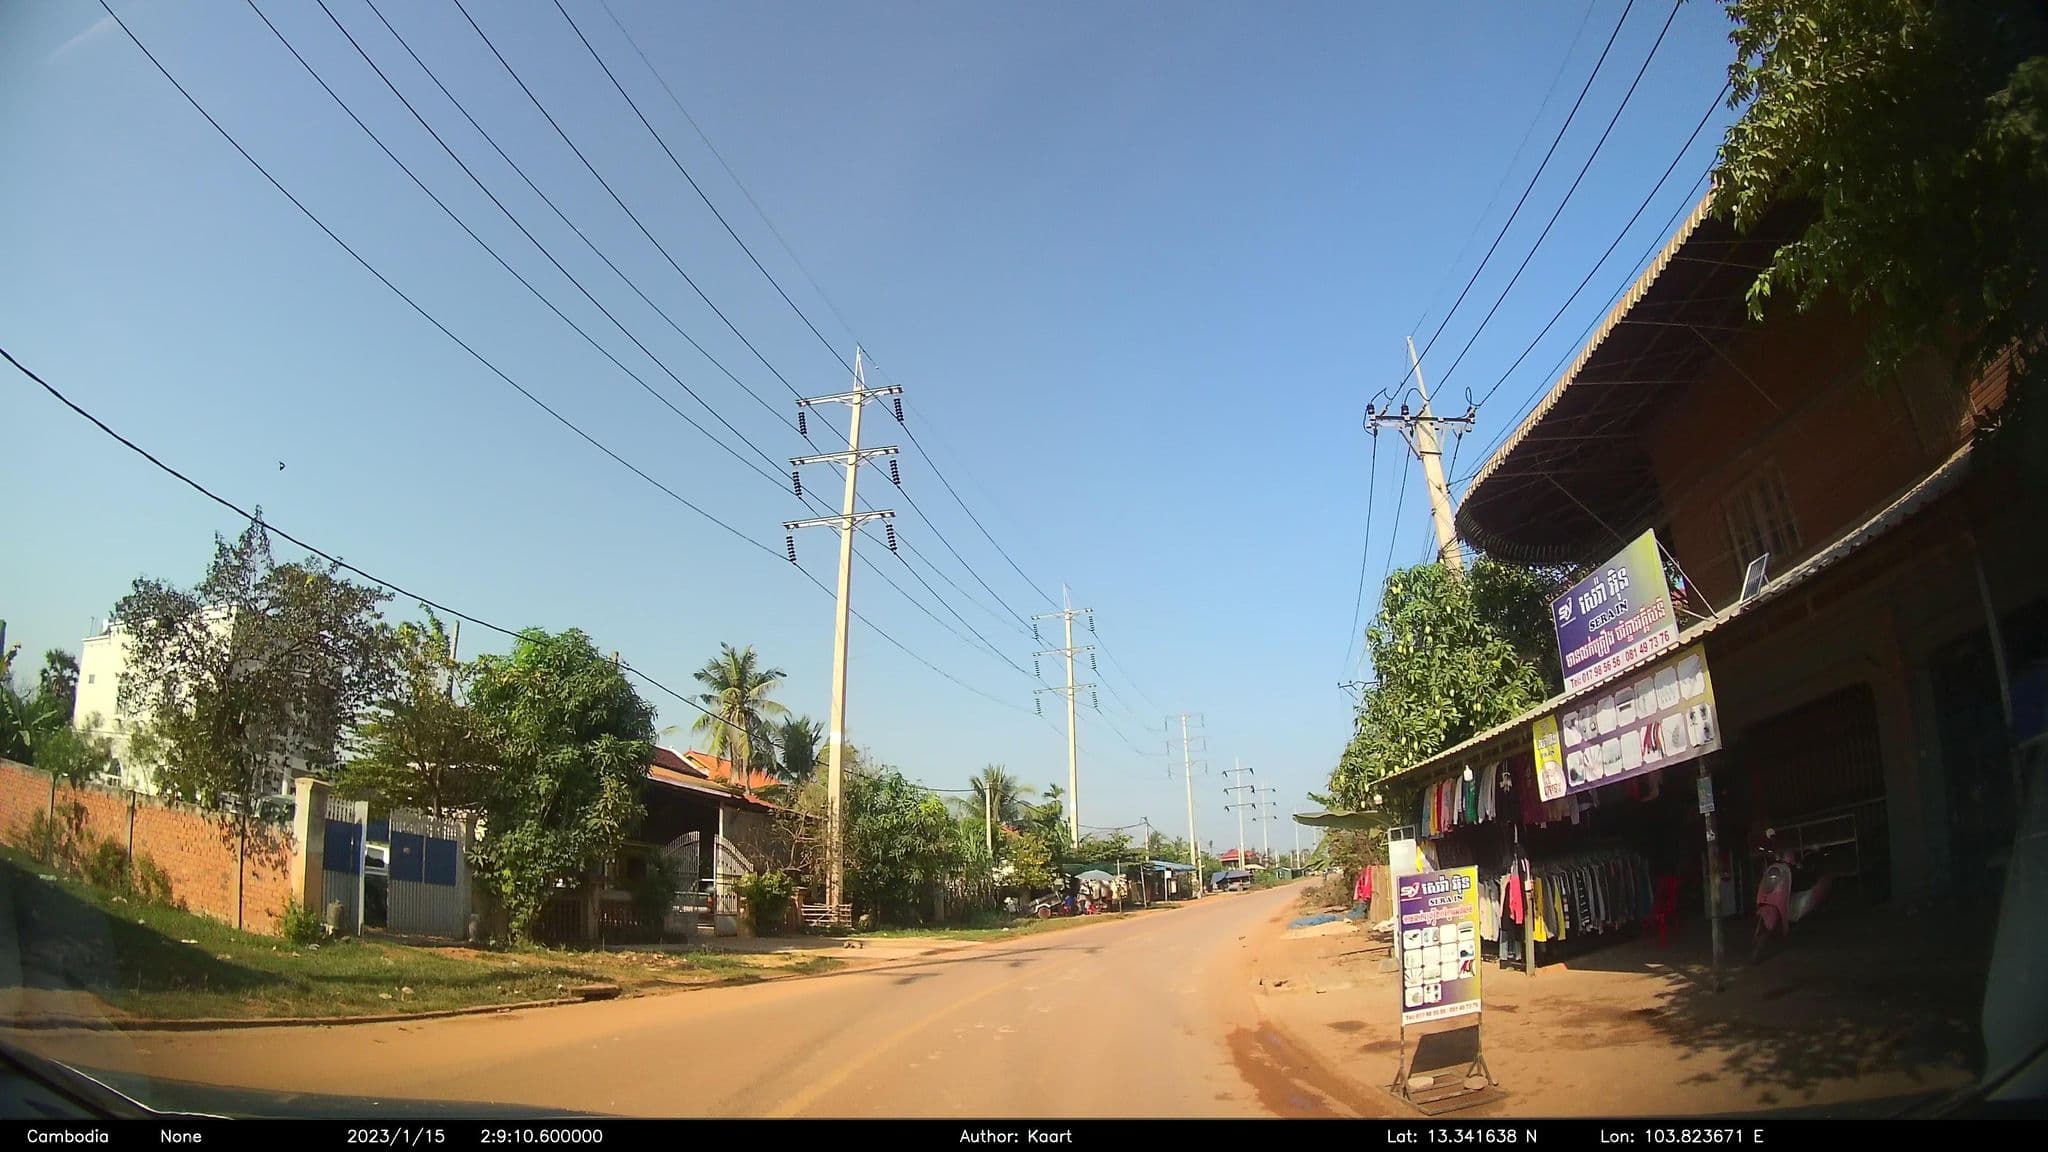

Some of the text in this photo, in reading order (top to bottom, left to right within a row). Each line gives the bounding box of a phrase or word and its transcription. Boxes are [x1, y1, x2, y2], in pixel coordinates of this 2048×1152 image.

[1589, 599, 1629, 632] SERA IN
[1581, 670, 1593, 684] 017
[1594, 666, 1602, 677] 98
[1603, 661, 1612, 673] 56
[1612, 655, 1621, 668] 56
[1625, 648, 1638, 662] 081
[1639, 642, 1648, 655] 49
[1649, 636, 1658, 650] 73
[1659, 630, 1670, 643] 76
